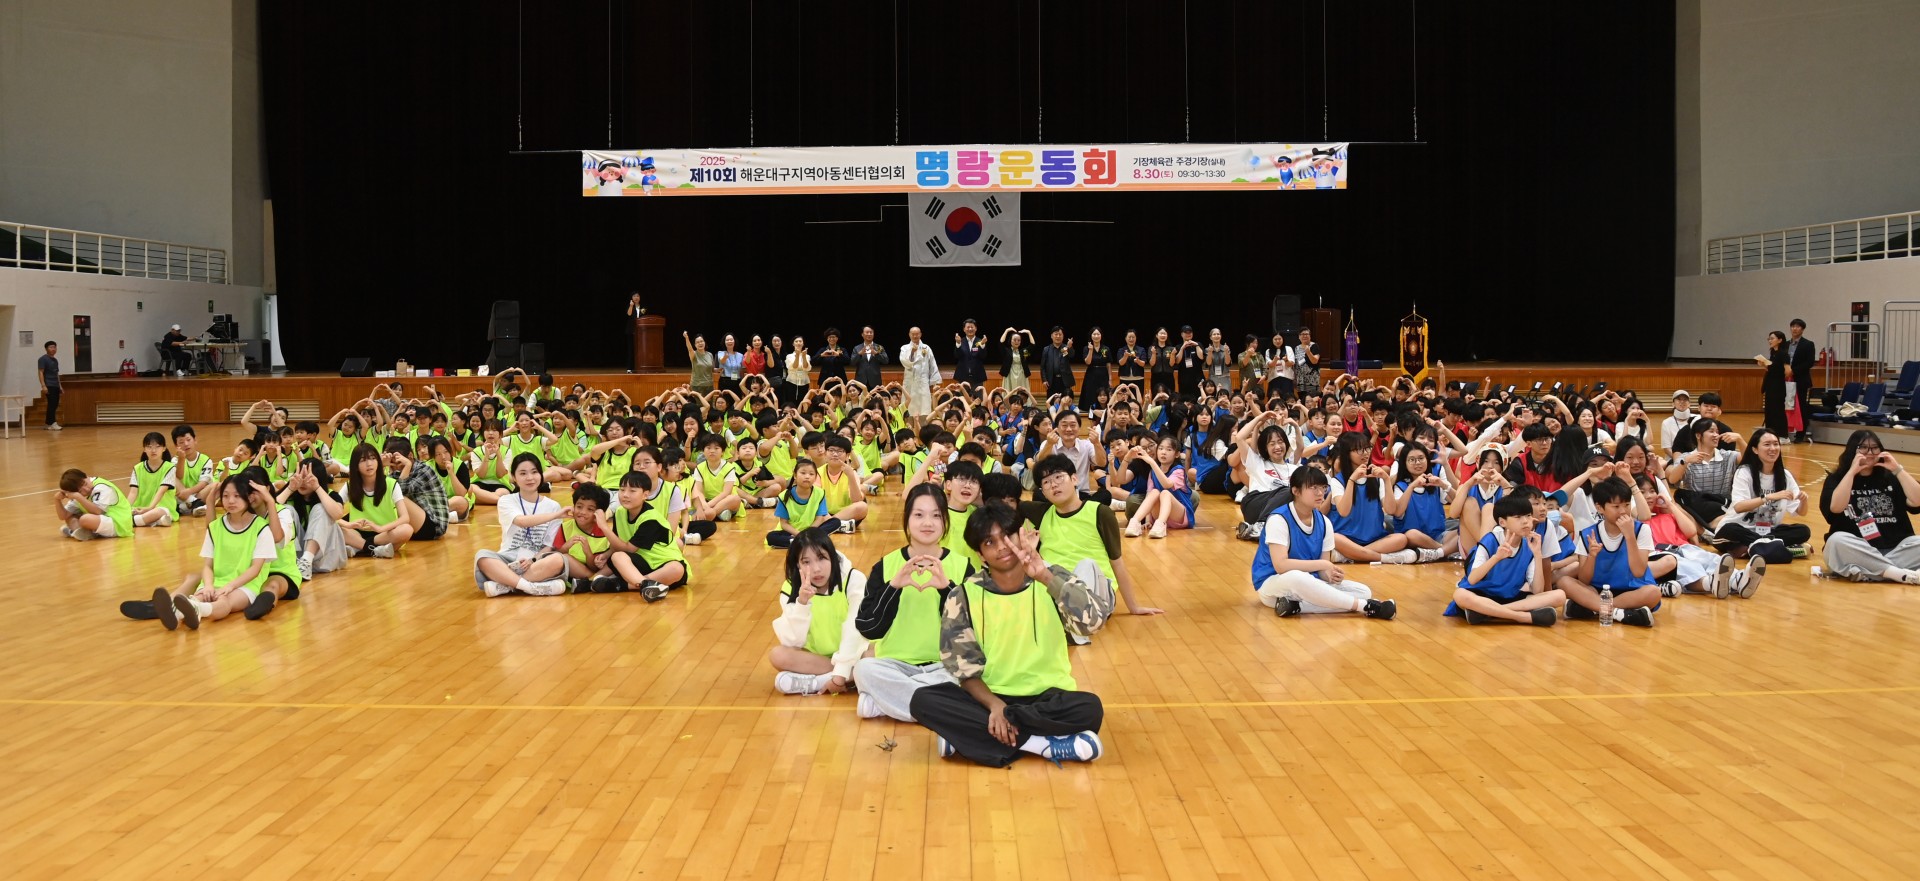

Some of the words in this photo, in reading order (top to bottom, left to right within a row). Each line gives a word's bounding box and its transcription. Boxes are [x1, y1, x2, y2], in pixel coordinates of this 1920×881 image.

[700, 156, 726, 166] 2025
[1133, 157, 1173, 167] 기장체육관
[1176, 157, 1226, 167] 주경기장(실내)
[915, 148, 1117, 186] 명랑운동회
[690, 167, 737, 182] 제10회
[740, 165, 905, 181] 해운대구지역아동센터협의회
[1133, 168, 1174, 179] 8.30(토)
[1177, 170, 1226, 178] 09:30~13:30
